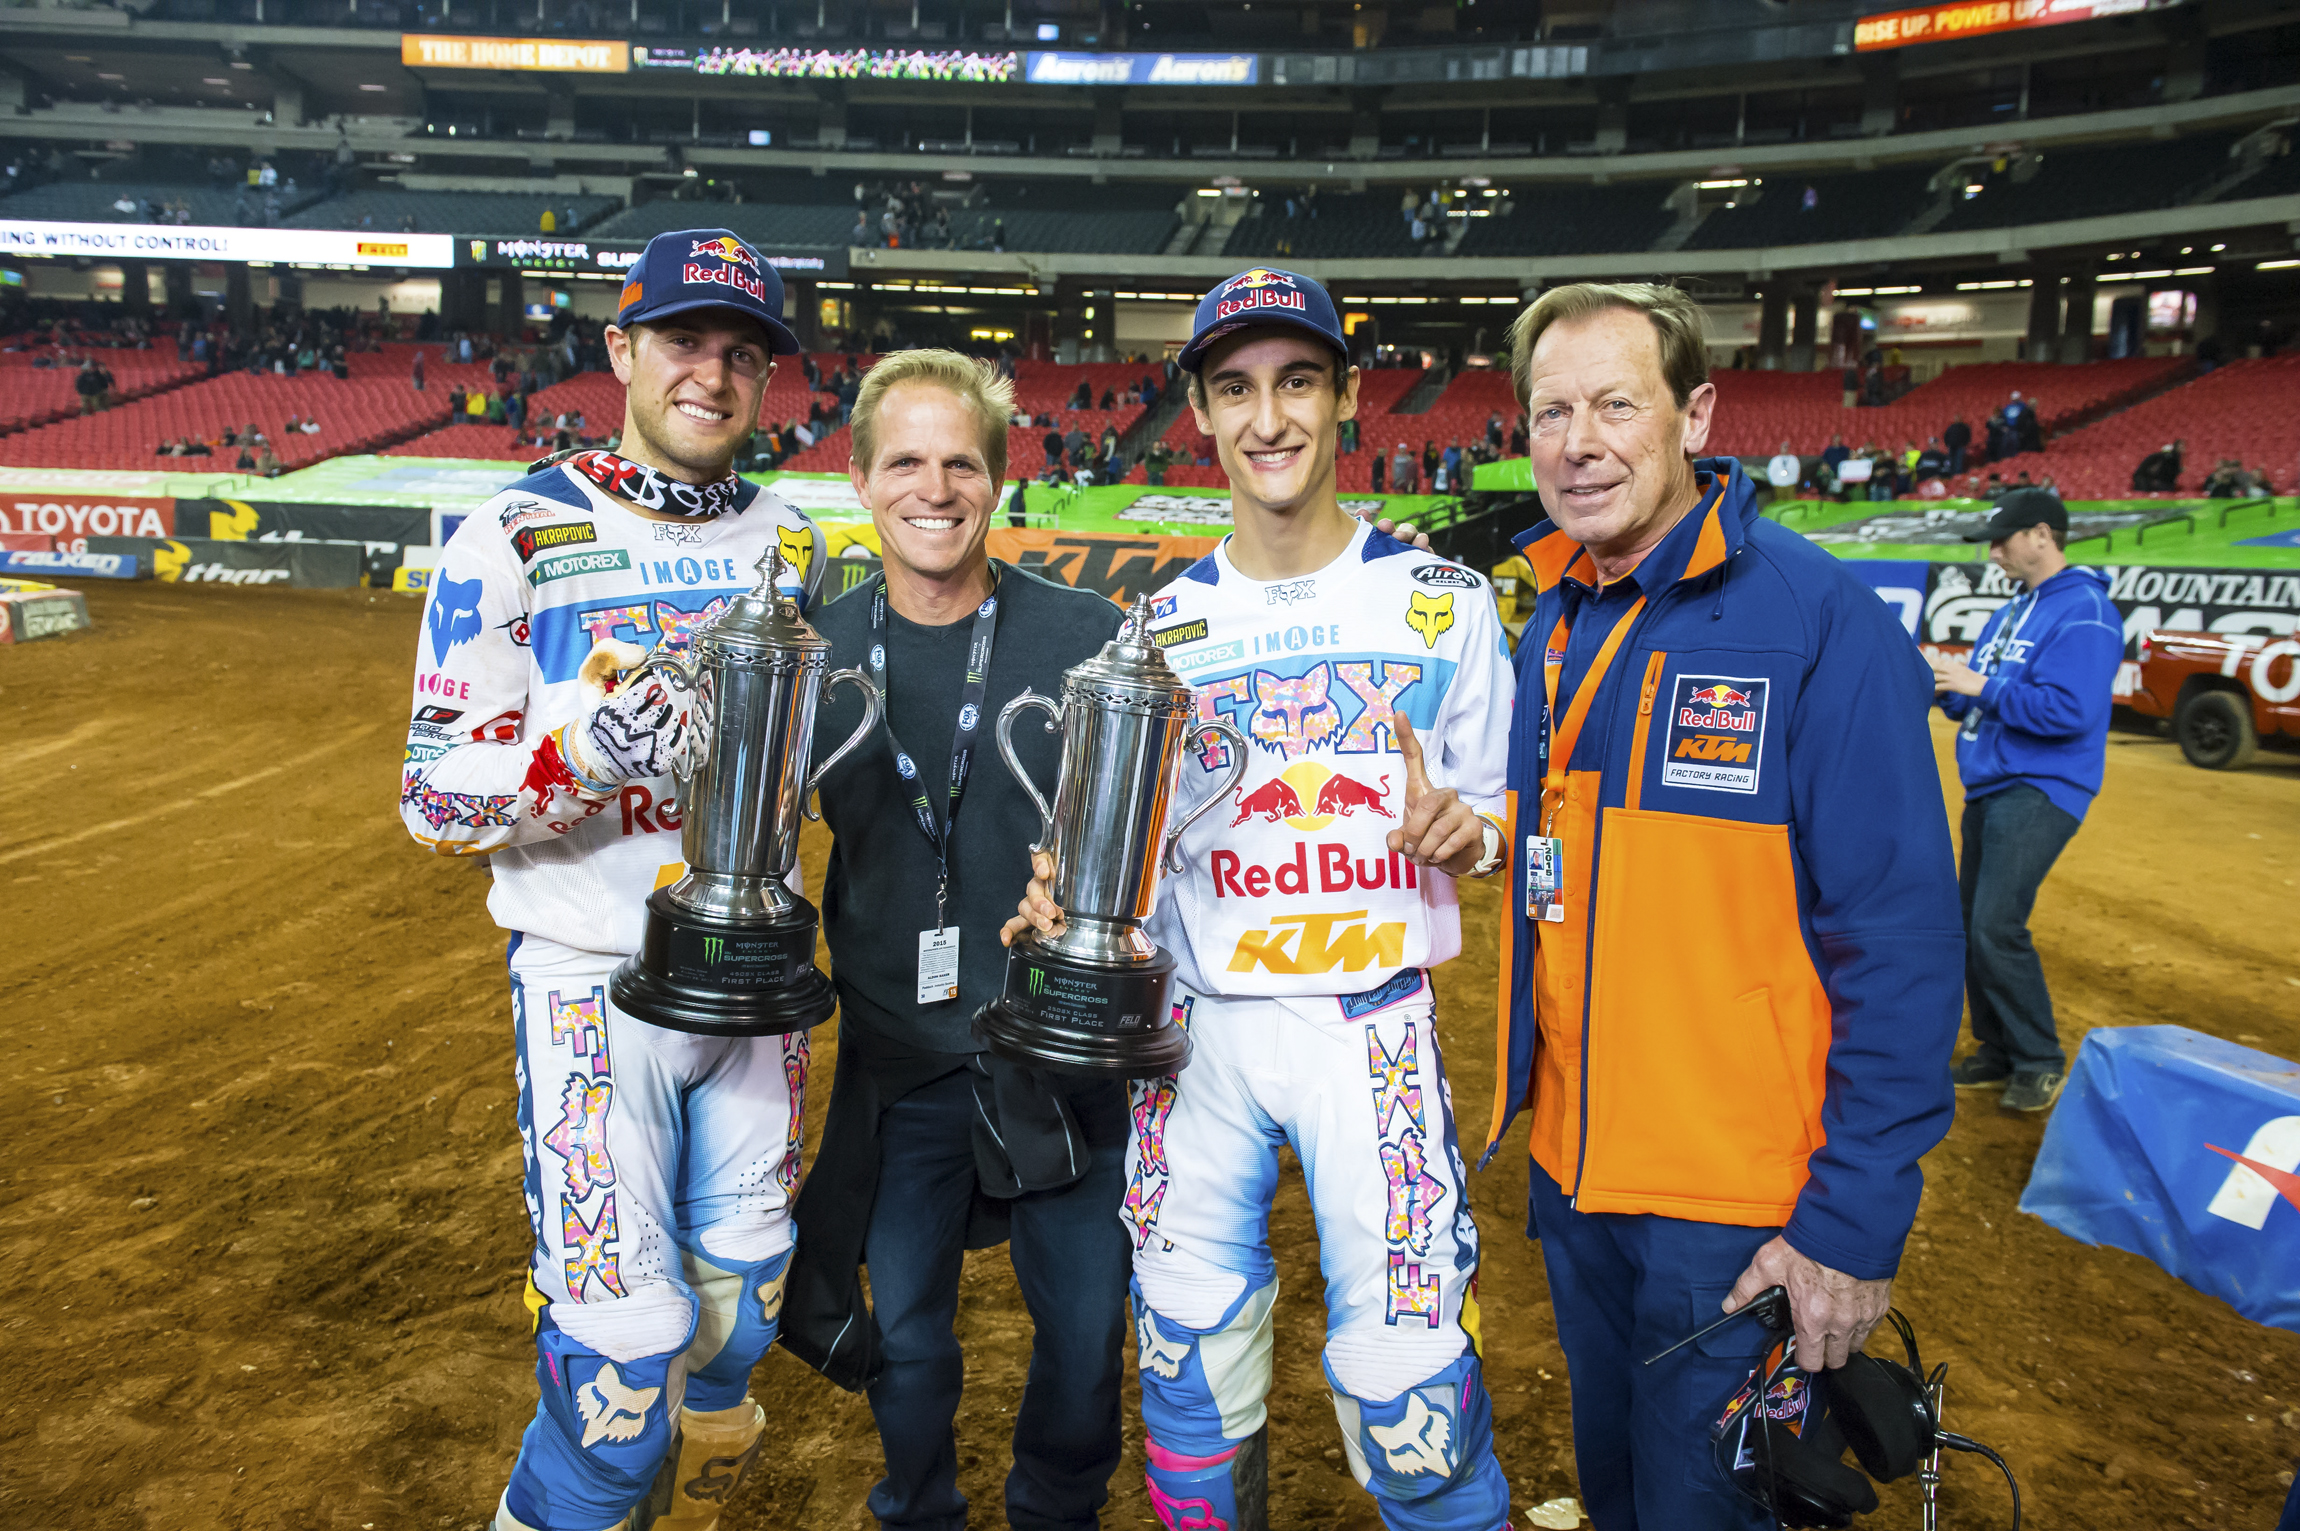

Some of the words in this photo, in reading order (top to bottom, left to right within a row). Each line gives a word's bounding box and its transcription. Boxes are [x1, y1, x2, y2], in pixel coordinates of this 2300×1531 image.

[1856, 19, 1899, 45] RISE
[1902, 14, 1932, 37] UP.
[1935, 3, 2010, 33] POWER
[419, 40, 466, 62] THE
[471, 42, 535, 65] HOME
[539, 44, 611, 67] DEPOT
[1031, 52, 1134, 81] Aaron's
[1148, 54, 1252, 82] Aaron's
[43, 232, 127, 248] WITHOUT
[134, 236, 227, 252] CONTROL!
[497, 240, 589, 260] MONSTER
[683, 263, 730, 285] Red
[731, 266, 766, 303] Bull
[1216, 289, 1259, 321] Red
[1260, 290, 1306, 311] Bull
[14, 503, 165, 537] TOYOTA
[503, 510, 556, 535] RENTHAL
[535, 524, 595, 547] AKRAPOVIČ
[652, 523, 701, 546] FOX
[8, 551, 122, 573] FALKEN
[543, 552, 623, 578] MOTOREX
[640, 557, 736, 585] IMAGE
[1417, 567, 1477, 586] Airoh
[1266, 579, 1316, 606] FOX
[1155, 621, 1206, 647] AKRAPOVIČ
[1254, 625, 1340, 655] IMAGE
[977, 636, 987, 672] SUPERCROSS
[962, 709, 970, 724] FOX
[1678, 707, 1717, 728] Red
[1716, 710, 1756, 731] Bull
[1674, 734, 1752, 763] KTM
[1670, 768, 1712, 780] FACTORY
[620, 785, 682, 836] Re
[1211, 842, 1309, 898] Red
[1318, 843, 1418, 893] Bull
[735, 941, 779, 949] MONSTER
[1226, 910, 1407, 974] KTM
[724, 953, 788, 962] SUPERCROSS
[755, 975, 785, 984] PLACE
[1054, 976, 1098, 991] MONSTER
[1043, 988, 1108, 1005] SUPERCROSS
[1040, 1010, 1067, 1022] FIRST
[1071, 1017, 1104, 1027] PLACE
[543, 985, 629, 1305] FOX
[1365, 1022, 1447, 1328] FOX
[1786, 1391, 1807, 1418] Bull
